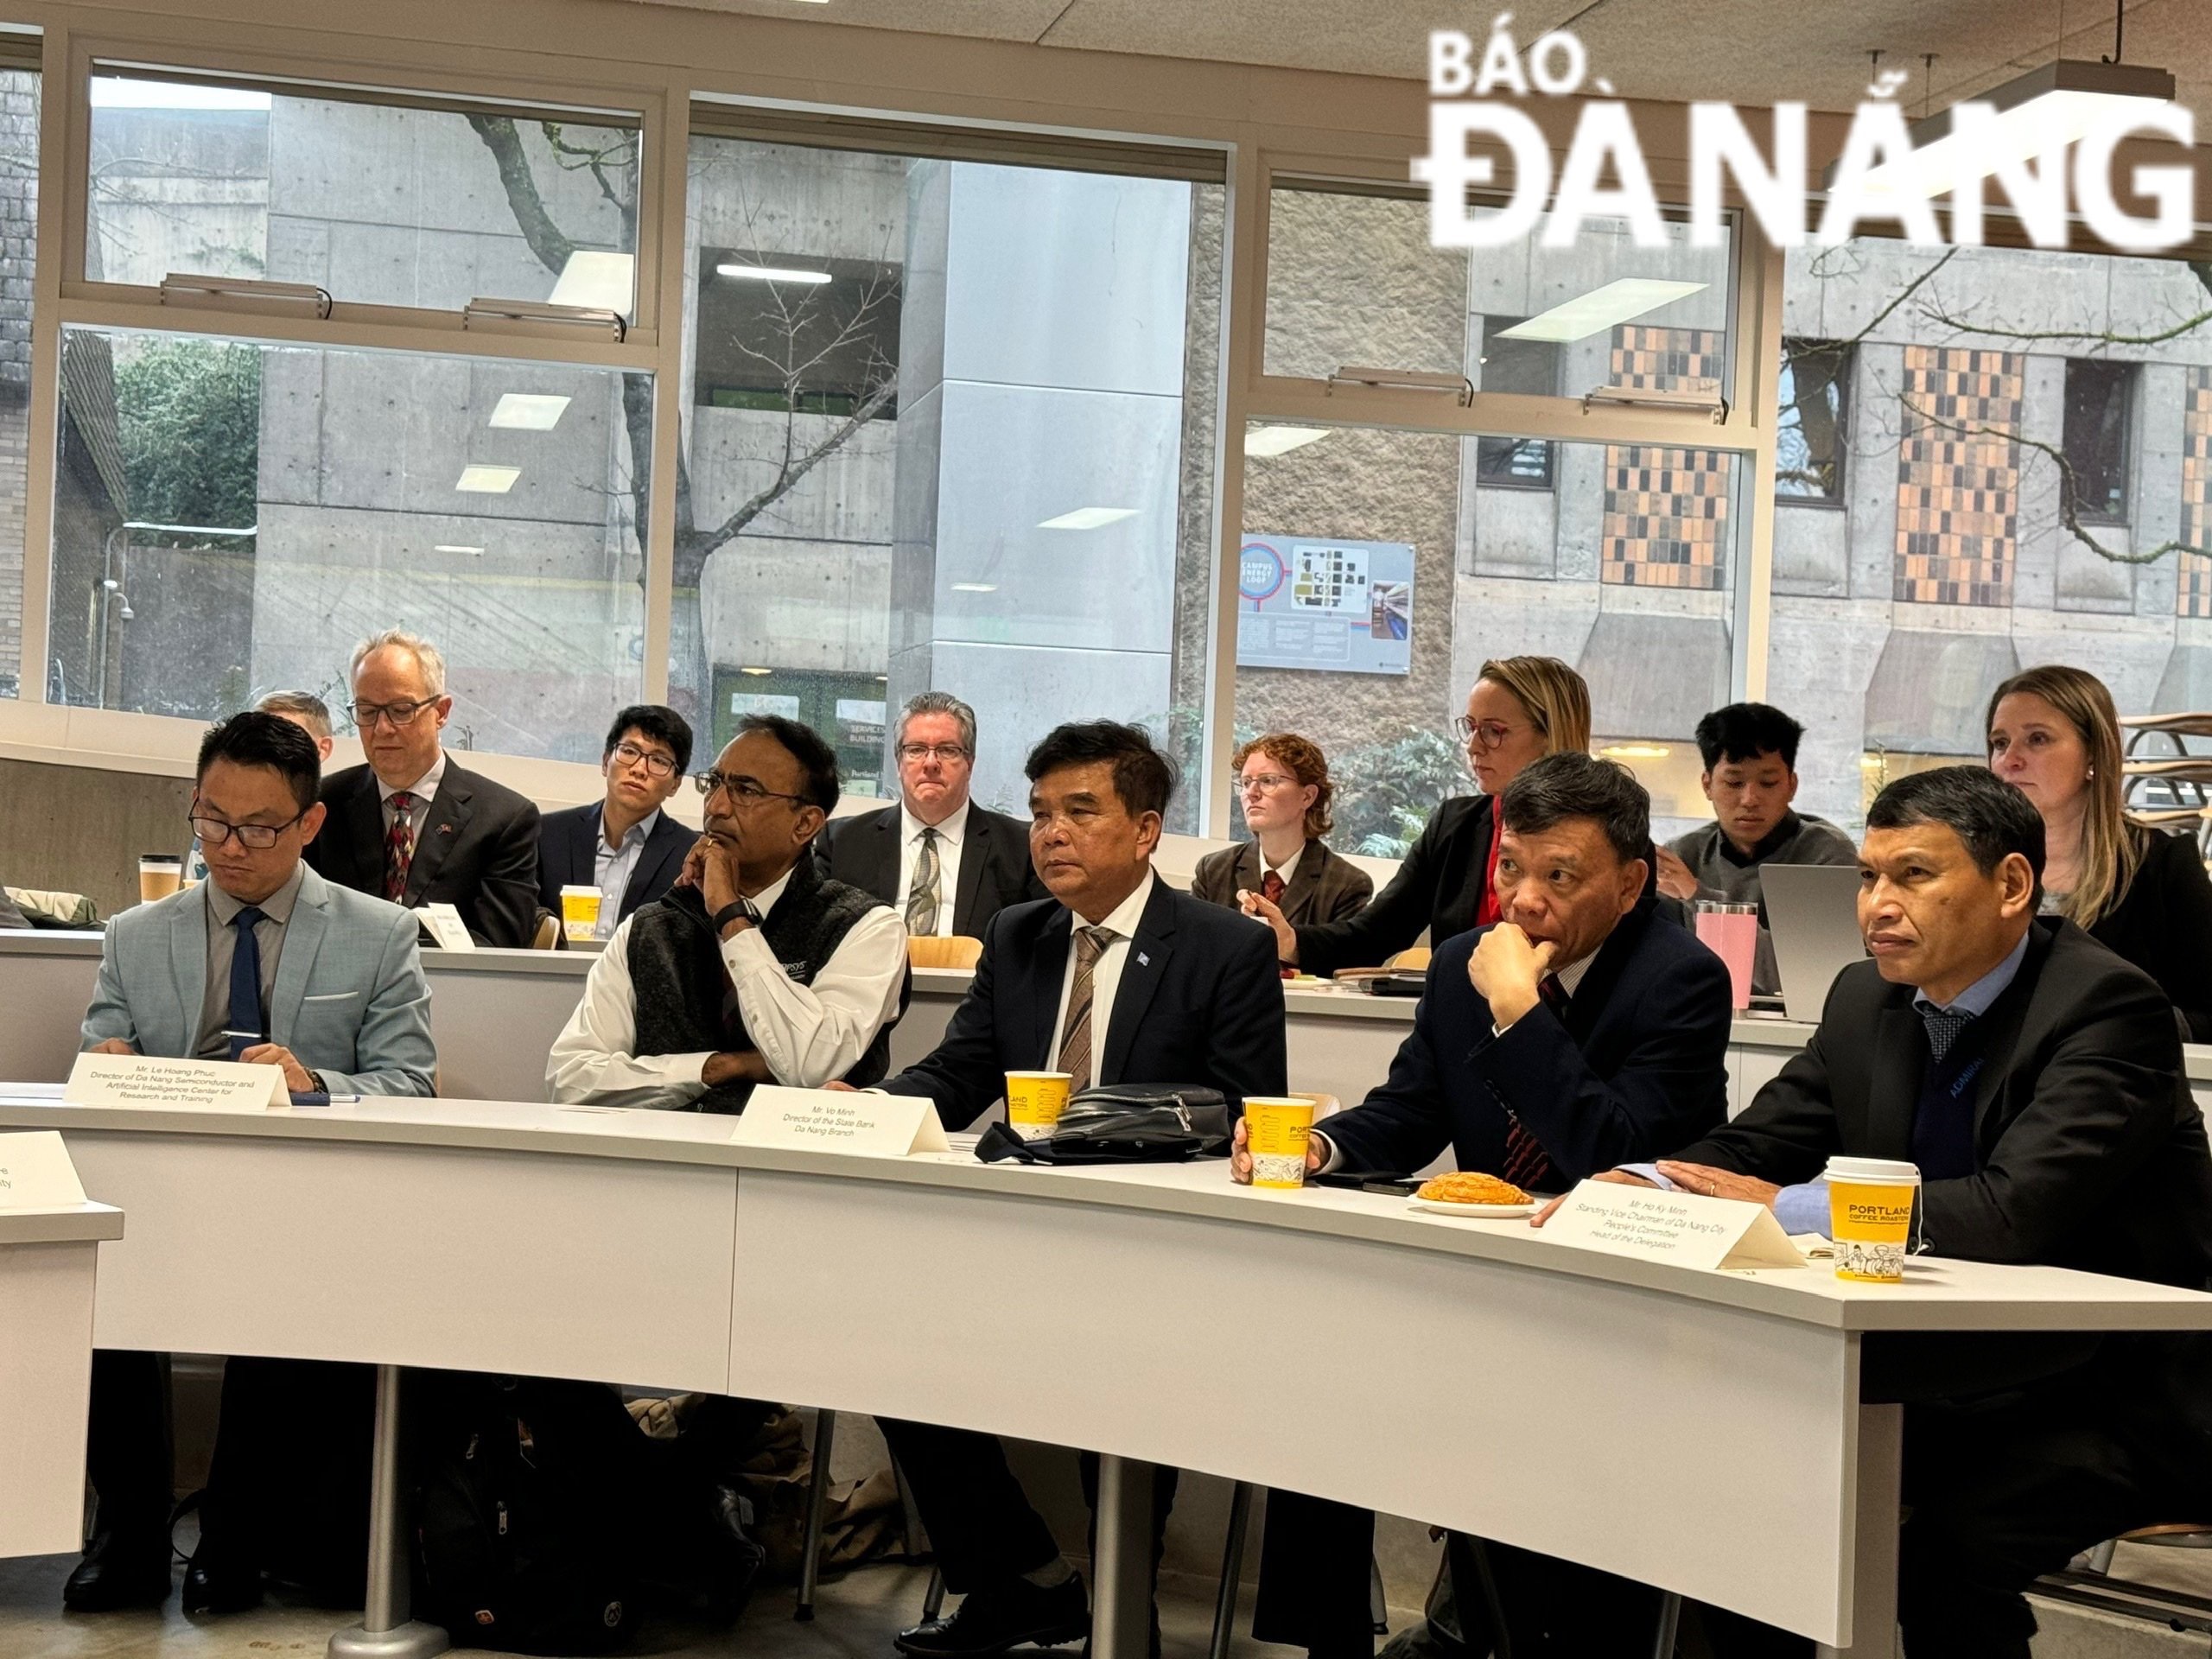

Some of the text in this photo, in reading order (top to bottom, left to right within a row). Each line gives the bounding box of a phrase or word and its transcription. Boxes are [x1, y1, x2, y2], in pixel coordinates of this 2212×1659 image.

[164, 1068, 192, 1077] Hoang
[194, 1069, 216, 1077] Phuc
[90, 1071, 124, 1080] Director
[149, 1075, 173, 1086] Nang
[175, 1077, 238, 1088] Semiconductor
[238, 1080, 256, 1089] and
[105, 1082, 141, 1090] Artificial
[141, 1083, 189, 1094] Intelligence
[190, 1086, 220, 1095] Center
[119, 1091, 160, 1100] Research
[181, 1094, 214, 1104] Training
[826, 1107, 836, 1116] Vo
[836, 1108, 856, 1117] Minh
[783, 1113, 875, 1128] Director of the State Bank
[794, 1124, 855, 1137] Da Nang Branch
[1642, 1202, 1656, 1211] Ho
[1849, 1204, 1910, 1216] PORTLAND
[1575, 1202, 1609, 1217] Standing
[1609, 1208, 1627, 1218] Vice
[1627, 1211, 1666, 1224] Chairman
[1674, 1218, 1688, 1229] Da
[1688, 1220, 1711, 1234] Nang
[1603, 1218, 1680, 1239] People's Committee
[1590, 1230, 1677, 1250] Head of the Delegation
